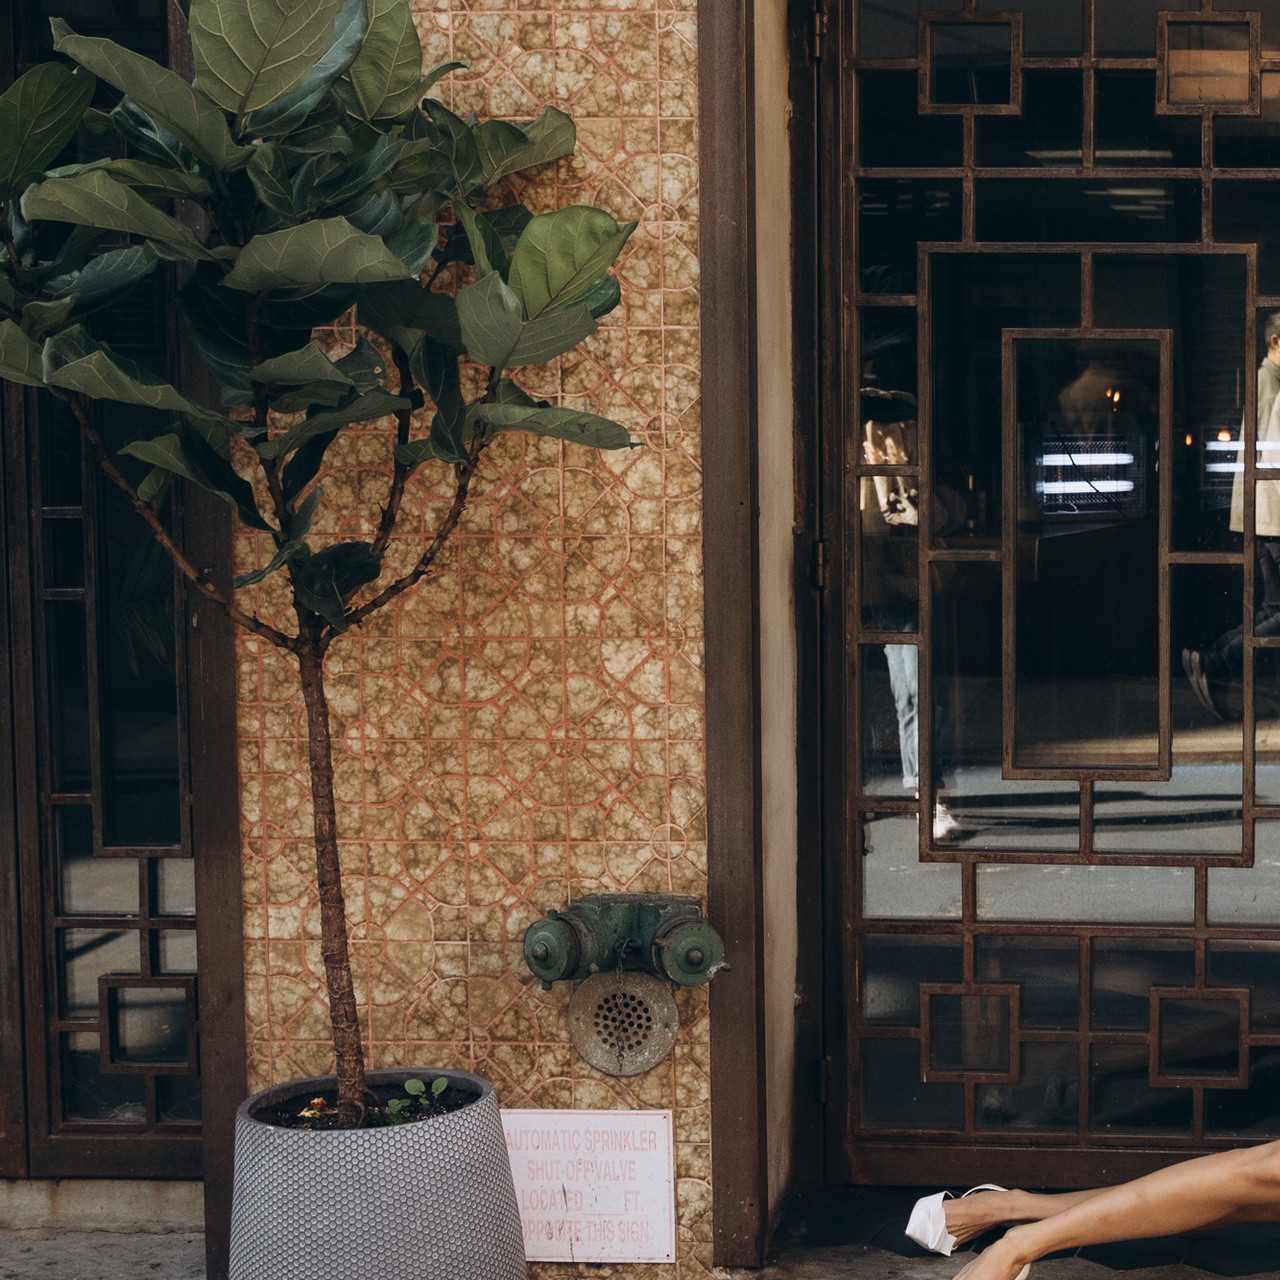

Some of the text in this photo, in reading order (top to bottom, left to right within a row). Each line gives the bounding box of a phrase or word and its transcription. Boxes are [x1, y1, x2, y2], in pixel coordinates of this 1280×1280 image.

[506, 1129, 657, 1151] AUTOMATIC SPRINKLER
[527, 1159, 637, 1181] SHUT-OFF VALVE
[522, 1189, 644, 1212] LOCATED FT.
[521, 1220, 649, 1243] OPPOSITE THIS SIGN
